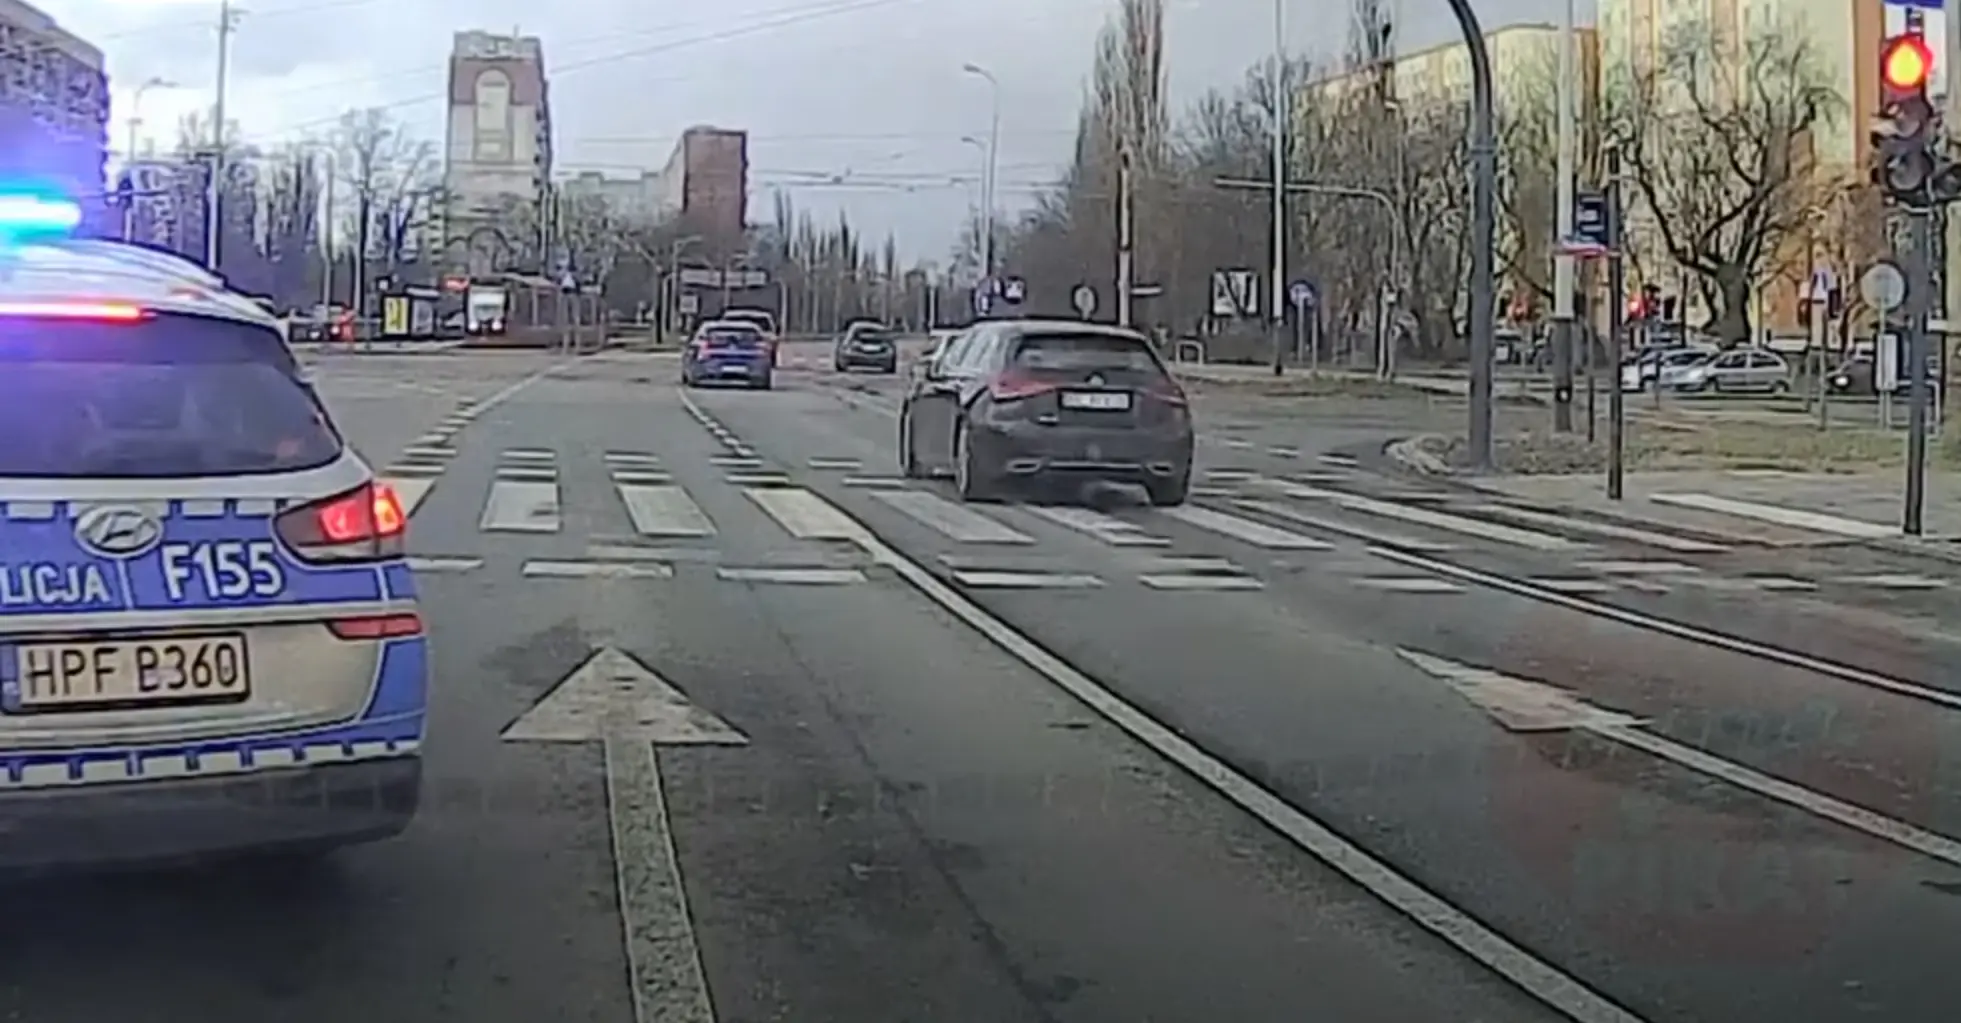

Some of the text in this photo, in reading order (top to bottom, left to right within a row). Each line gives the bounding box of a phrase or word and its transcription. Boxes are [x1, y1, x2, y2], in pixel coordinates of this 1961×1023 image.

[0, 565, 110, 604] LICJA
[162, 543, 281, 599] F155
[27, 643, 238, 696] HPF B360
